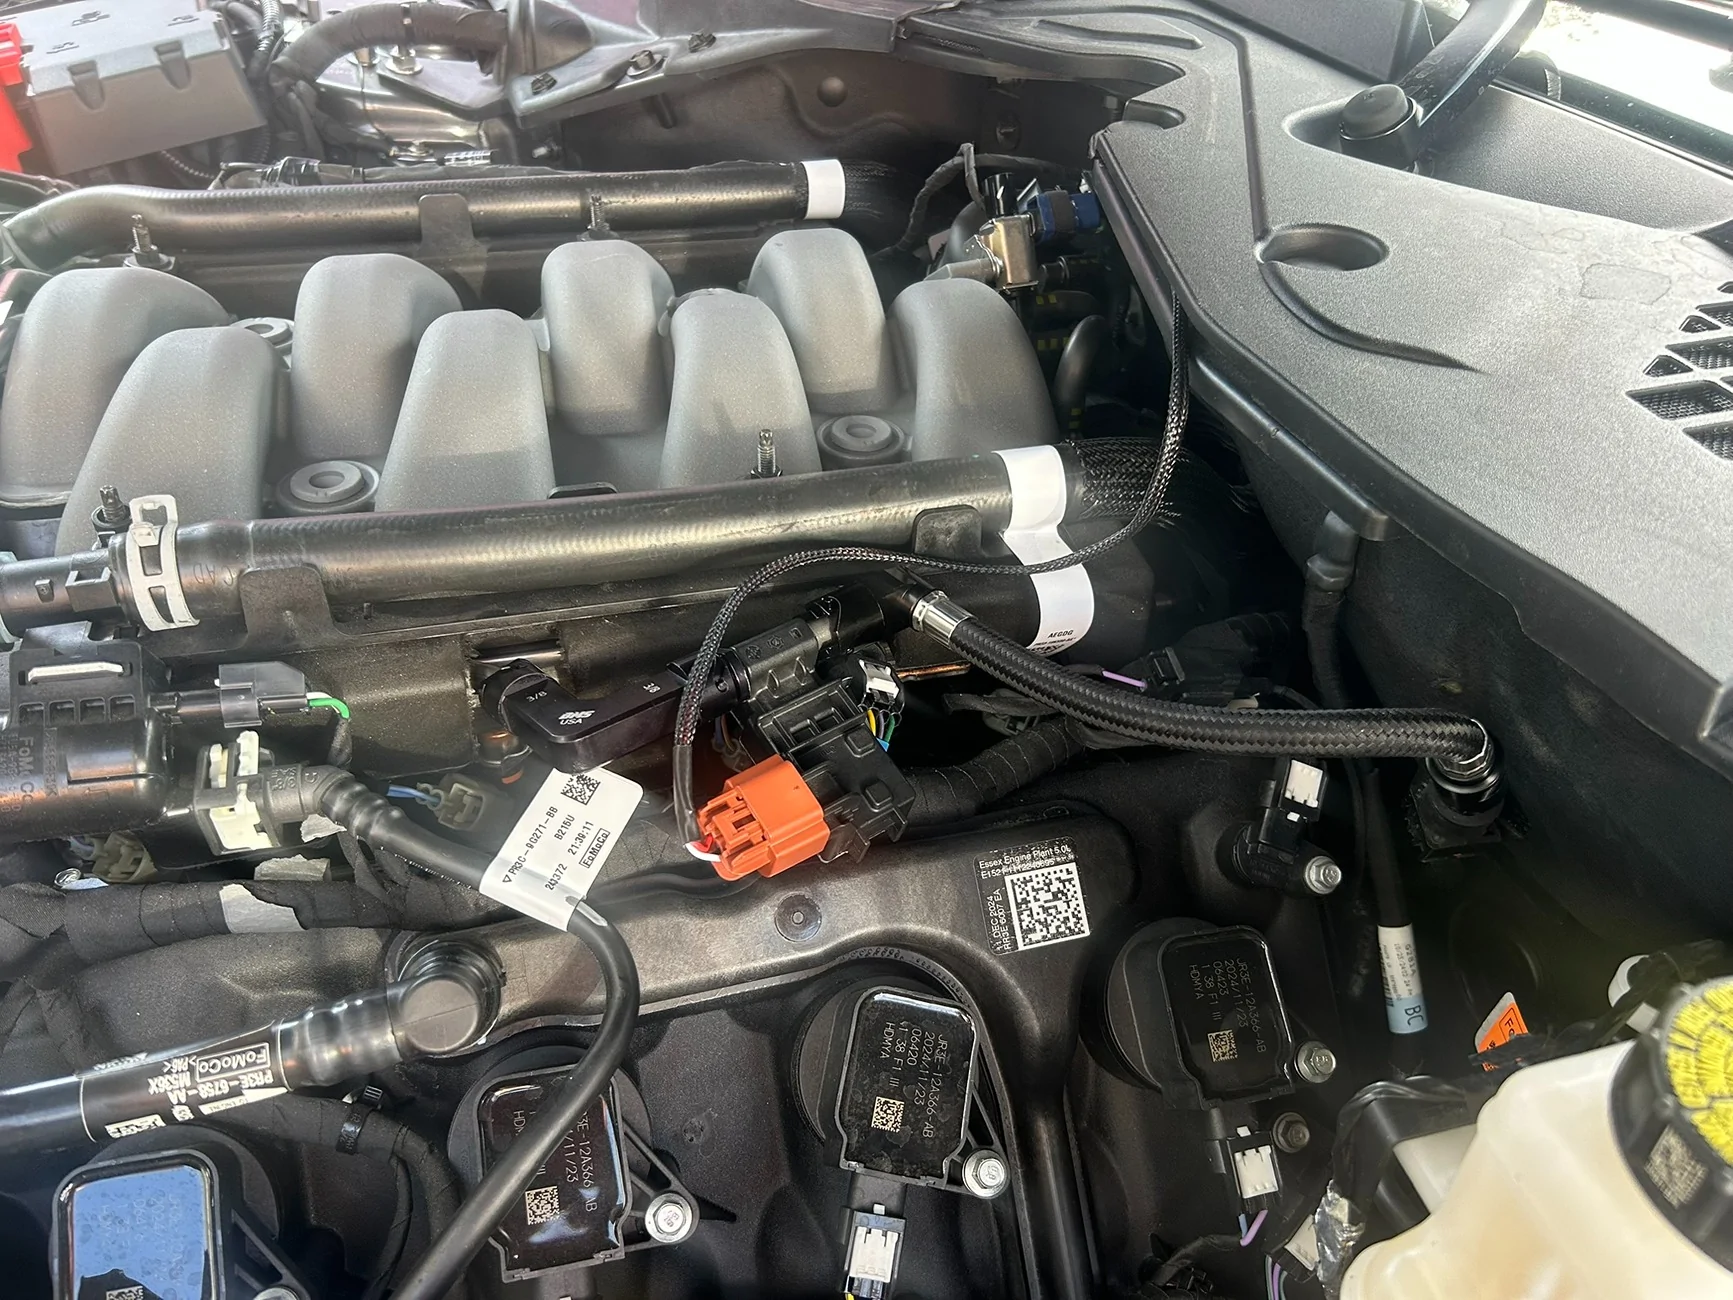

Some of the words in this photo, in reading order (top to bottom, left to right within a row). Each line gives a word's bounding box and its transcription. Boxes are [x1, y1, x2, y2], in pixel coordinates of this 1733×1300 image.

[560, 718, 583, 726] USA
[567, 820, 594, 856] 21:39:11
[583, 832, 609, 867] FoMoCo
[979, 858, 1002, 869] Essex
[1004, 853, 1032, 865] Engine
[1032, 849, 1054, 859] Plant
[993, 888, 1002, 902] EA
[986, 895, 996, 917] 2024
[996, 902, 1006, 925] 6007
[990, 918, 1001, 938] DEC
[1204, 975, 1215, 988] 38
[1224, 959, 1249, 1028] 2024/11/23
[1404, 1005, 1425, 1026] BC
[895, 1038, 907, 1053] 38
[198, 1048, 267, 1074] FoMoCo
[892, 1057, 904, 1071] F1
[913, 1031, 935, 1106] 2024/11/23
[922, 1034, 948, 1138] JR3E-12A366-AB
